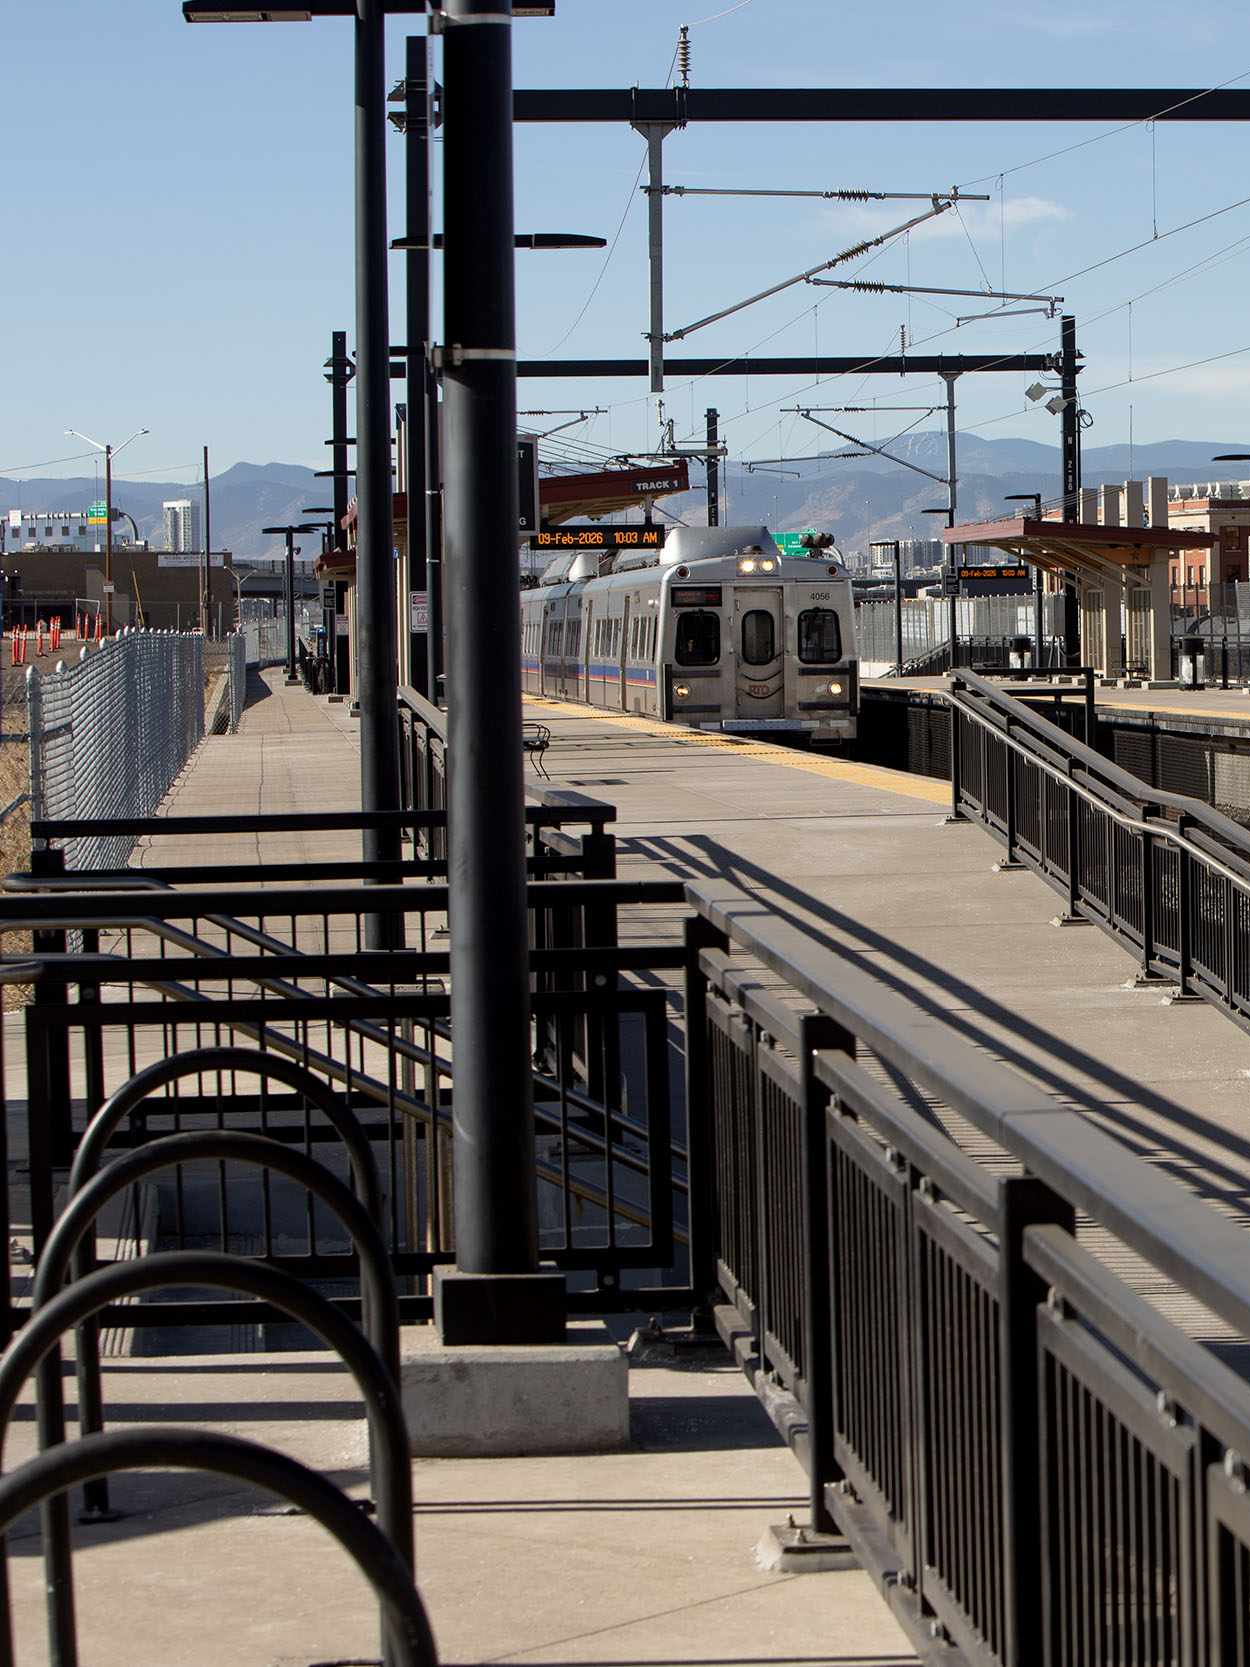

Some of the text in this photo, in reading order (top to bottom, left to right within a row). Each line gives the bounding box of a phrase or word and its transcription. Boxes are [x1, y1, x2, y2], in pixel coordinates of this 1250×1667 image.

[636, 480, 679, 491] TRACK 1
[538, 531, 658, 545] 09-Feb-2026 10:03 AM
[810, 592, 830, 601] 4056
